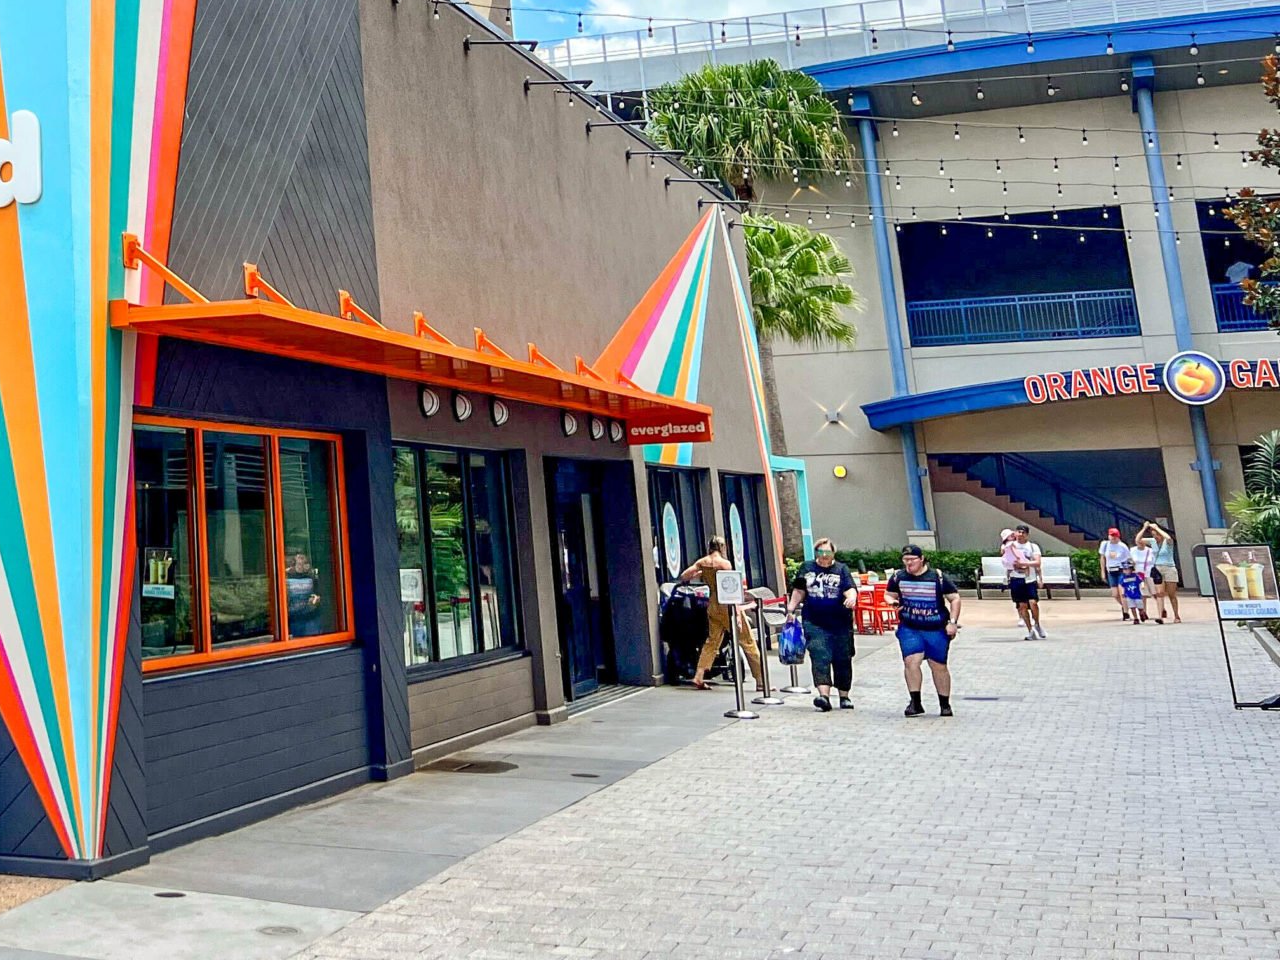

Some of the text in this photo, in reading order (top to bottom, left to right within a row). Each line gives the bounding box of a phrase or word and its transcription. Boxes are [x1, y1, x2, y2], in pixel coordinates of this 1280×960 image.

[1024, 357, 1280, 404] ORANGE GA
[630, 421, 706, 437] everglazed
